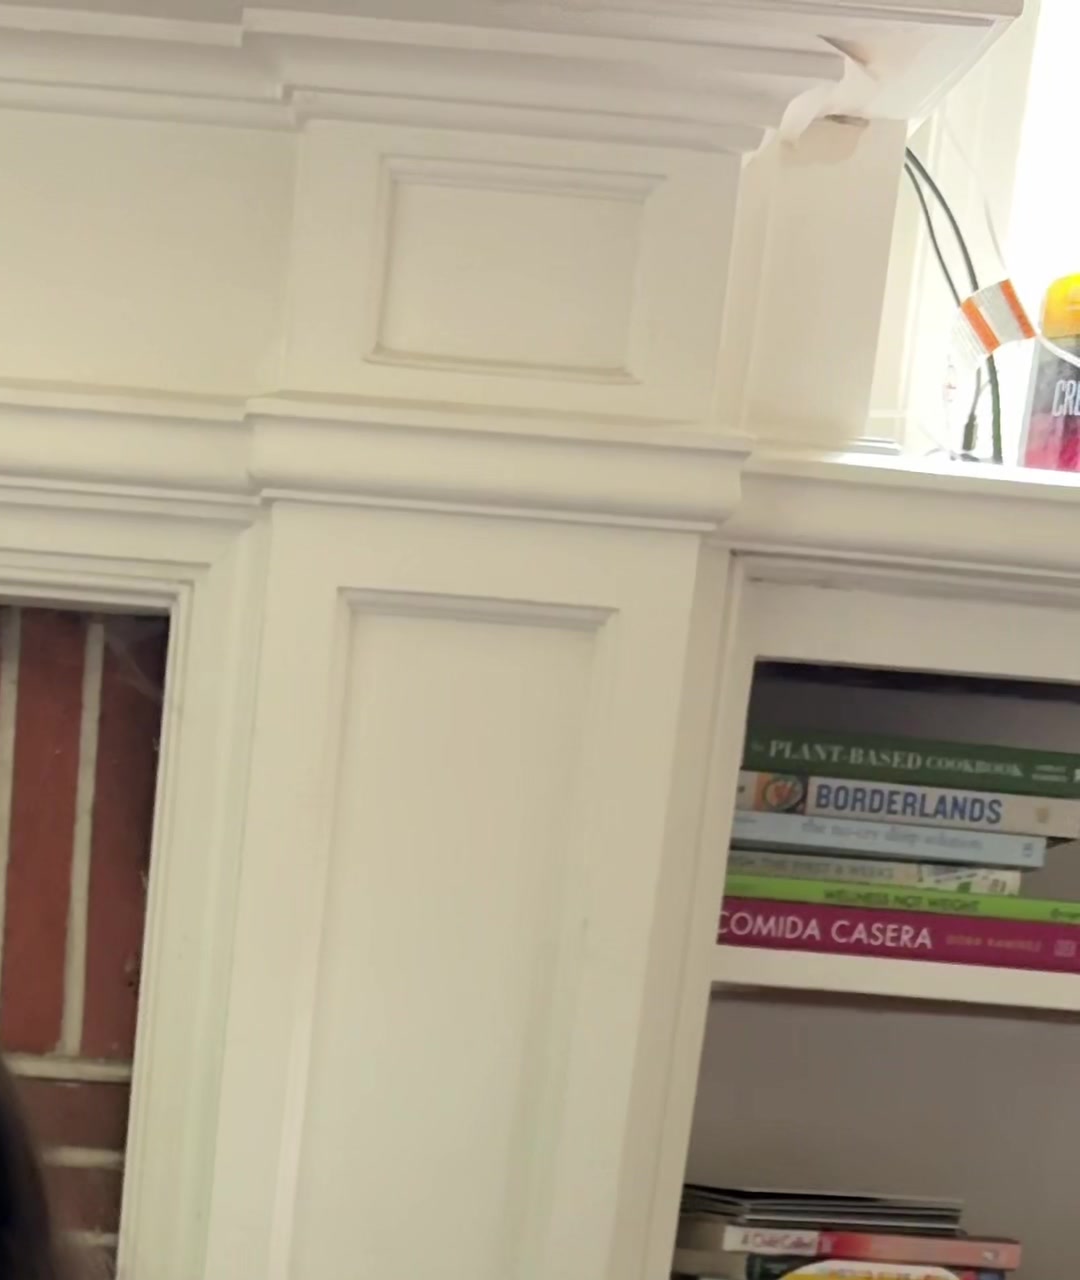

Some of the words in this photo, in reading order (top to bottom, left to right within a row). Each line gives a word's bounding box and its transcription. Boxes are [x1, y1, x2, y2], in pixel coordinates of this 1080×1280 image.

[769, 739, 922, 770] PLANT-BASED
[814, 784, 1002, 824] BORDERLANDS
[718, 911, 822, 942] COMIDA
[831, 920, 933, 949] CASERA
